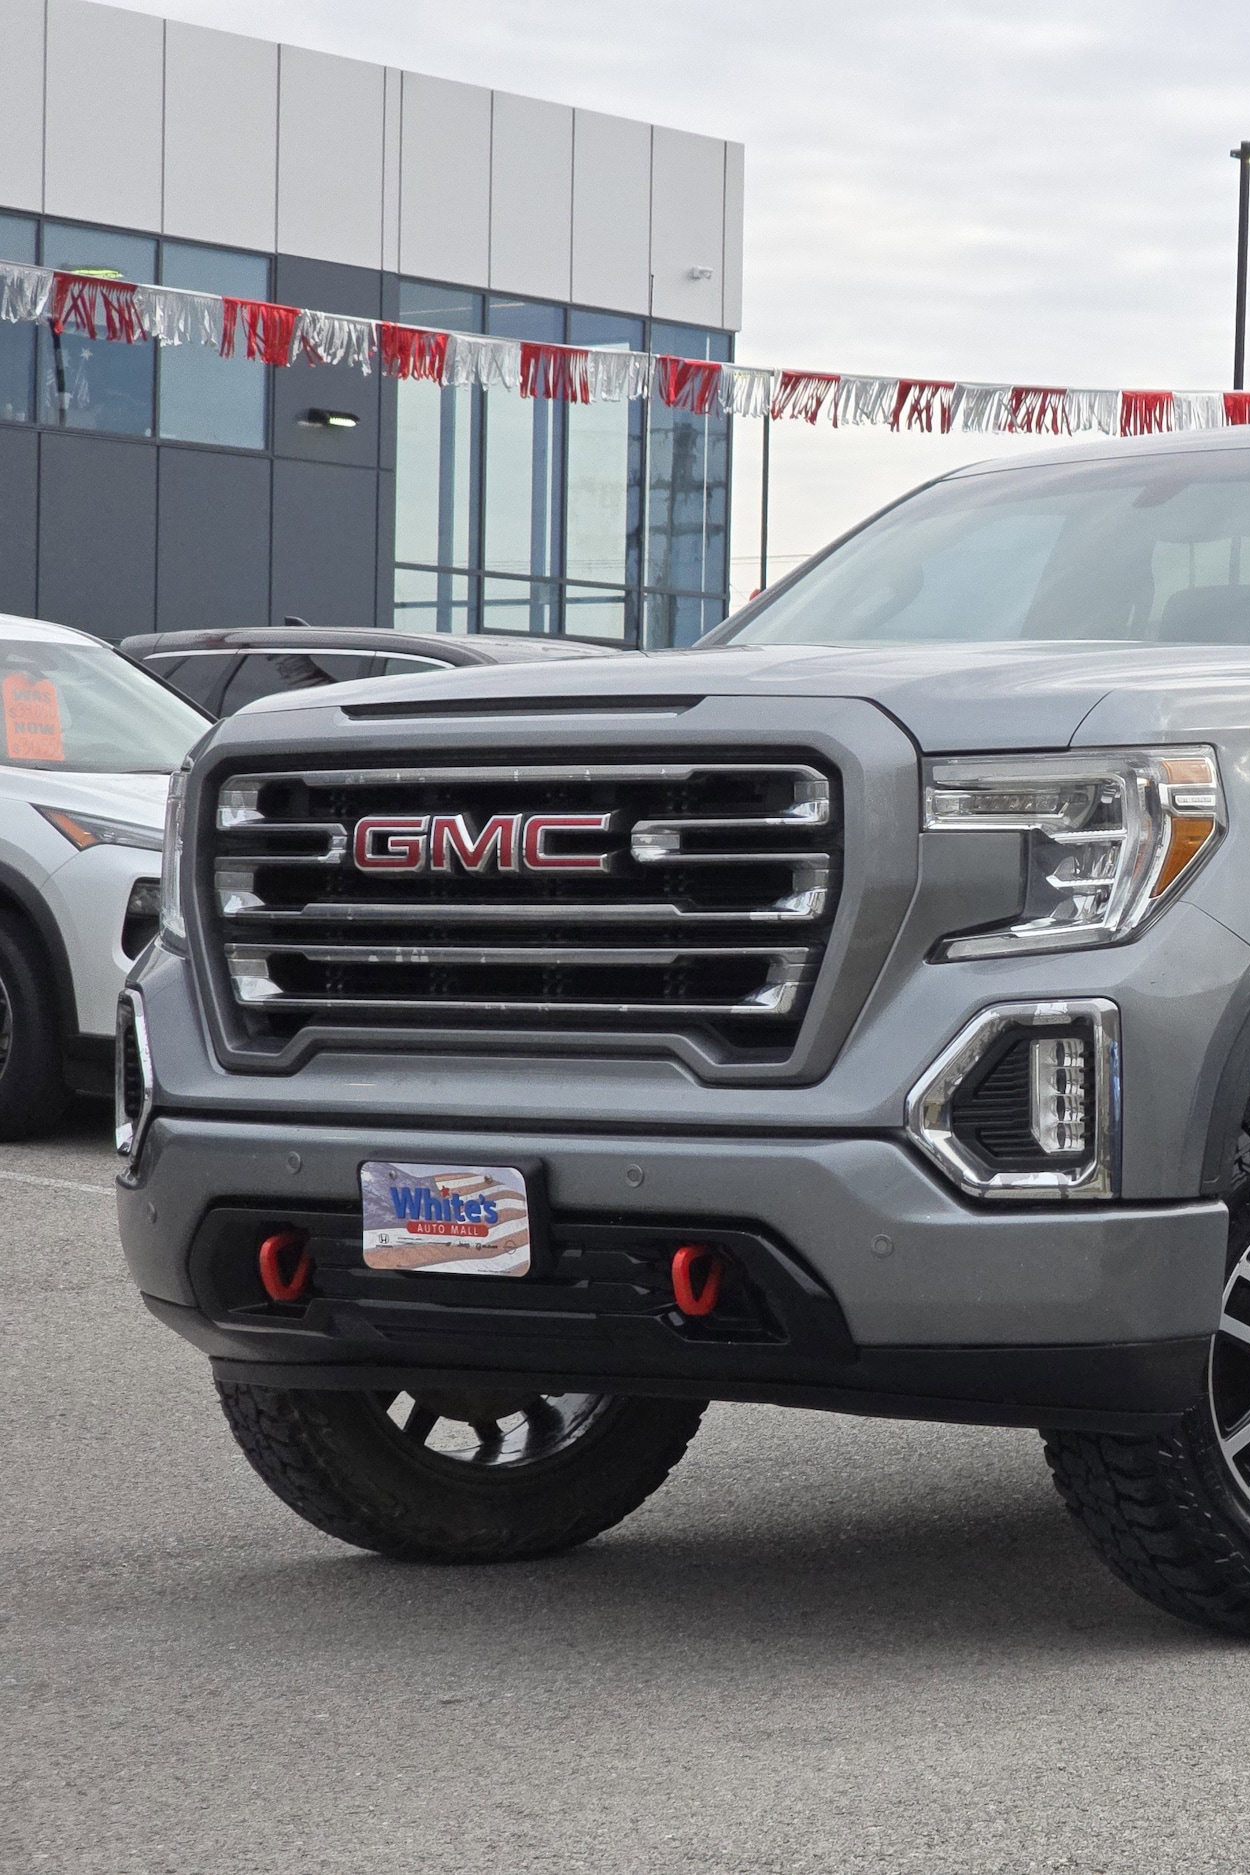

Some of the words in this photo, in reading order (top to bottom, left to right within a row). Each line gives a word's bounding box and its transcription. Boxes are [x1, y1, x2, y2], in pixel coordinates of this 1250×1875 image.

[12, 689, 51, 704] WAS
[14, 721, 55, 735] NOW
[354, 812, 613, 873] GMC
[389, 1185, 498, 1224] White's
[416, 1223, 445, 1234] AUTO
[451, 1225, 479, 1236] MALL
